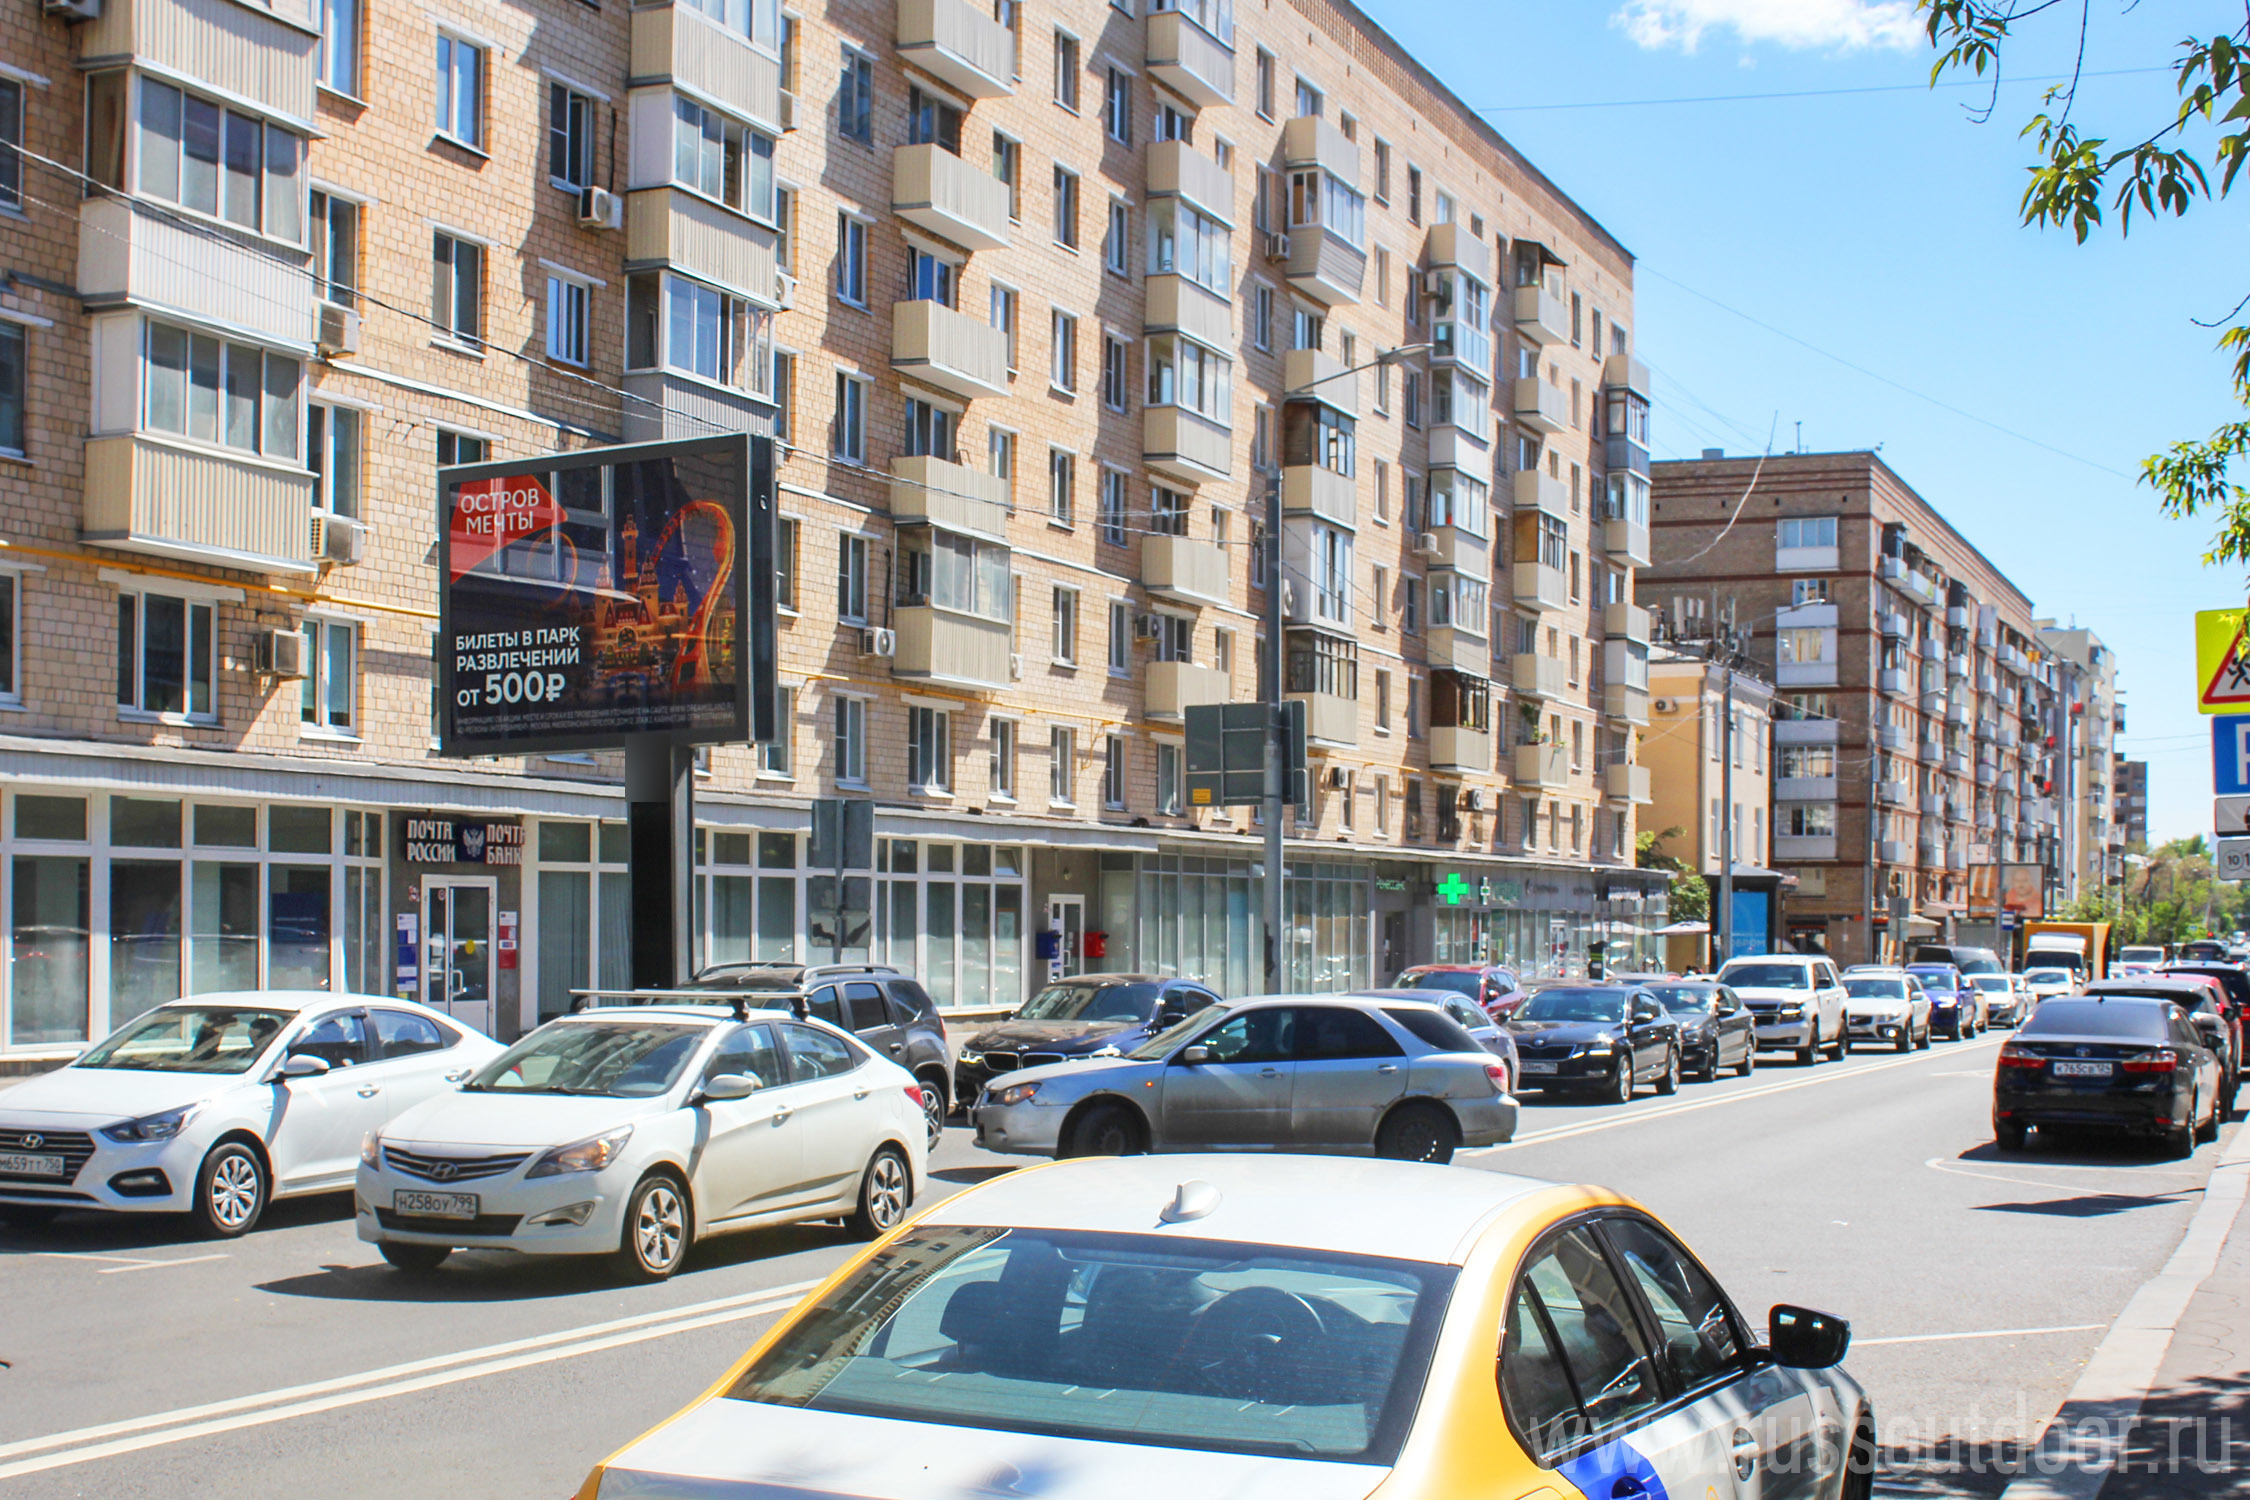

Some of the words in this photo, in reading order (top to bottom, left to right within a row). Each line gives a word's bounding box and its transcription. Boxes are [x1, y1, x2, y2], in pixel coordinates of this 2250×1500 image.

[460, 487, 540, 514] ОСТРОВ
[465, 510, 534, 536] МЕЧТЫ
[455, 631, 518, 651] БИЛЕТЫ
[522, 630, 533, 646] В
[536, 626, 580, 645] ПАРК
[456, 642, 580, 672] РАЗВЛЕЧЕНИЙ
[407, 819, 453, 840] ПОЧТА
[486, 824, 526, 845] ПОЧТА
[407, 842, 456, 863] РОССИИ
[486, 845, 521, 865] БАНК
[2227, 854, 2240, 866] 10
